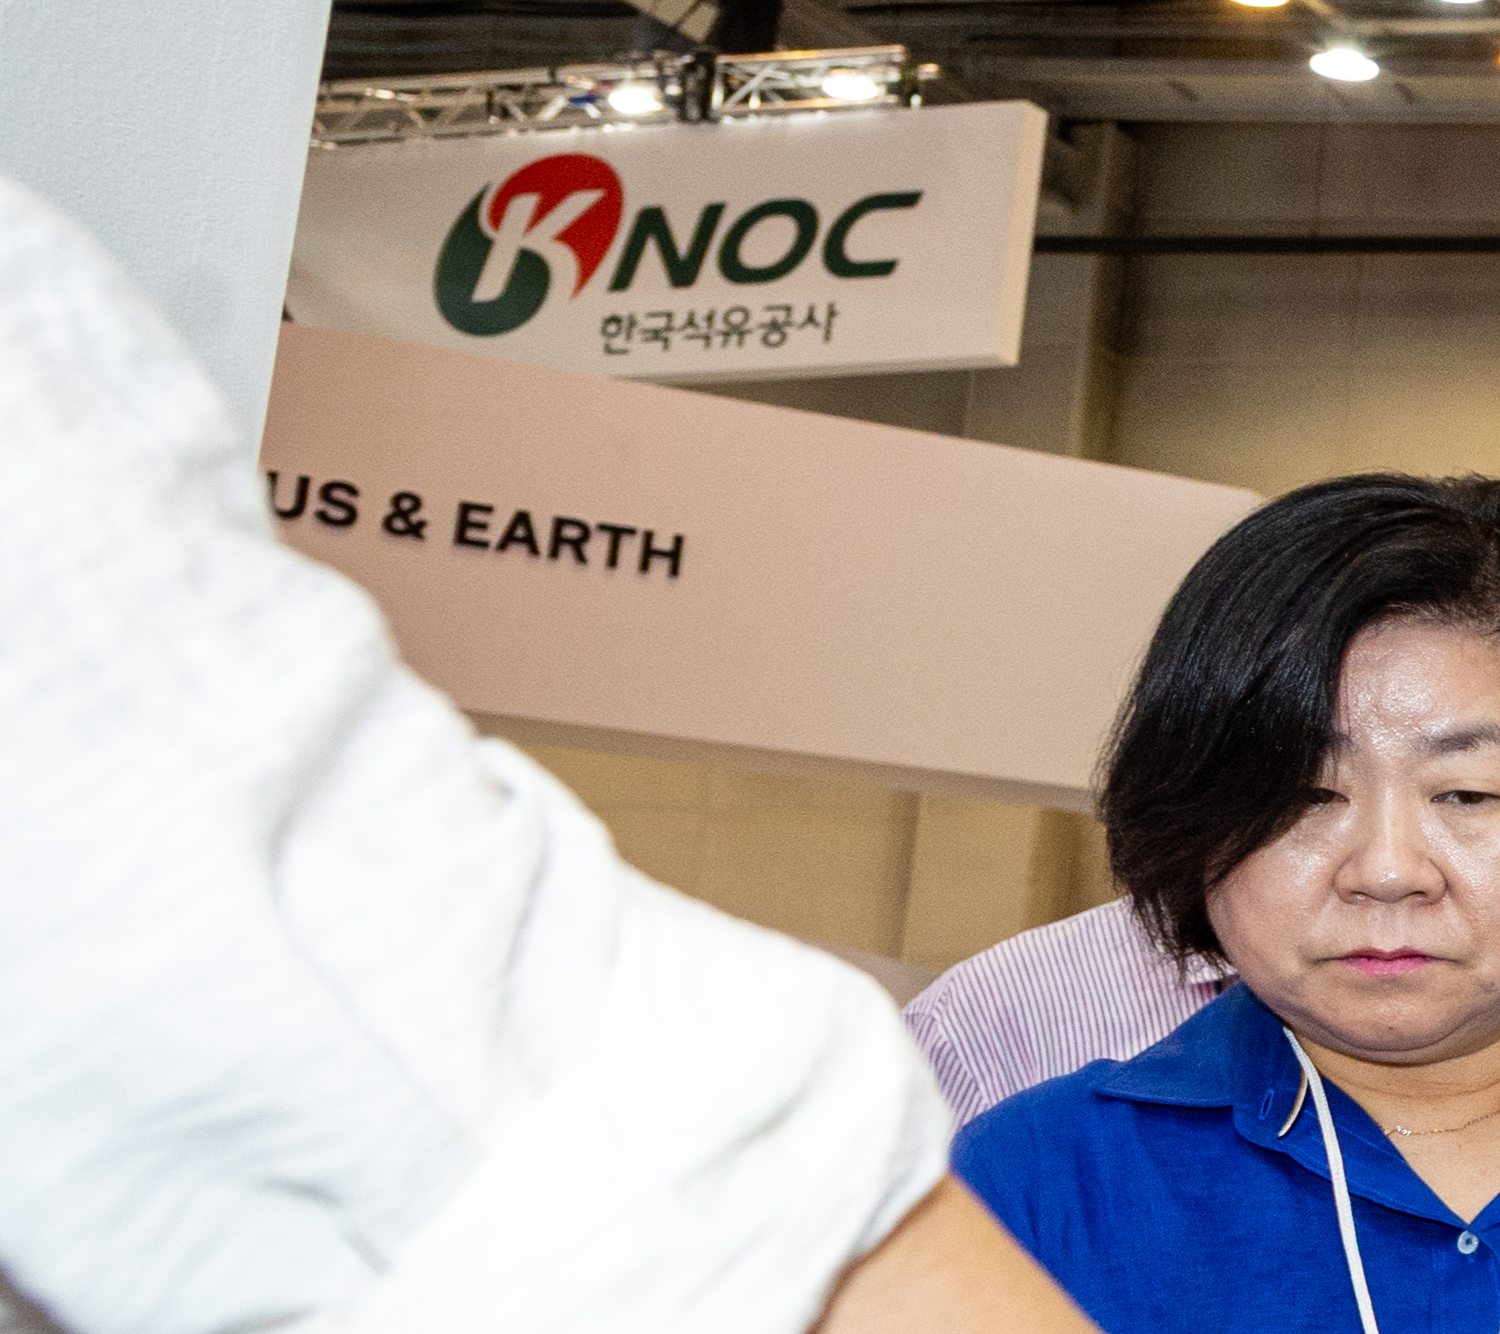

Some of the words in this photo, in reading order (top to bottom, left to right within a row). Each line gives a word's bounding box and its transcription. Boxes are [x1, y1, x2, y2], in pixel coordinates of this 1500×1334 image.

[438, 161, 924, 323] KNOC
[600, 302, 839, 356] 한국석유공사
[381, 491, 428, 540] &
[453, 501, 686, 578] EARTH
